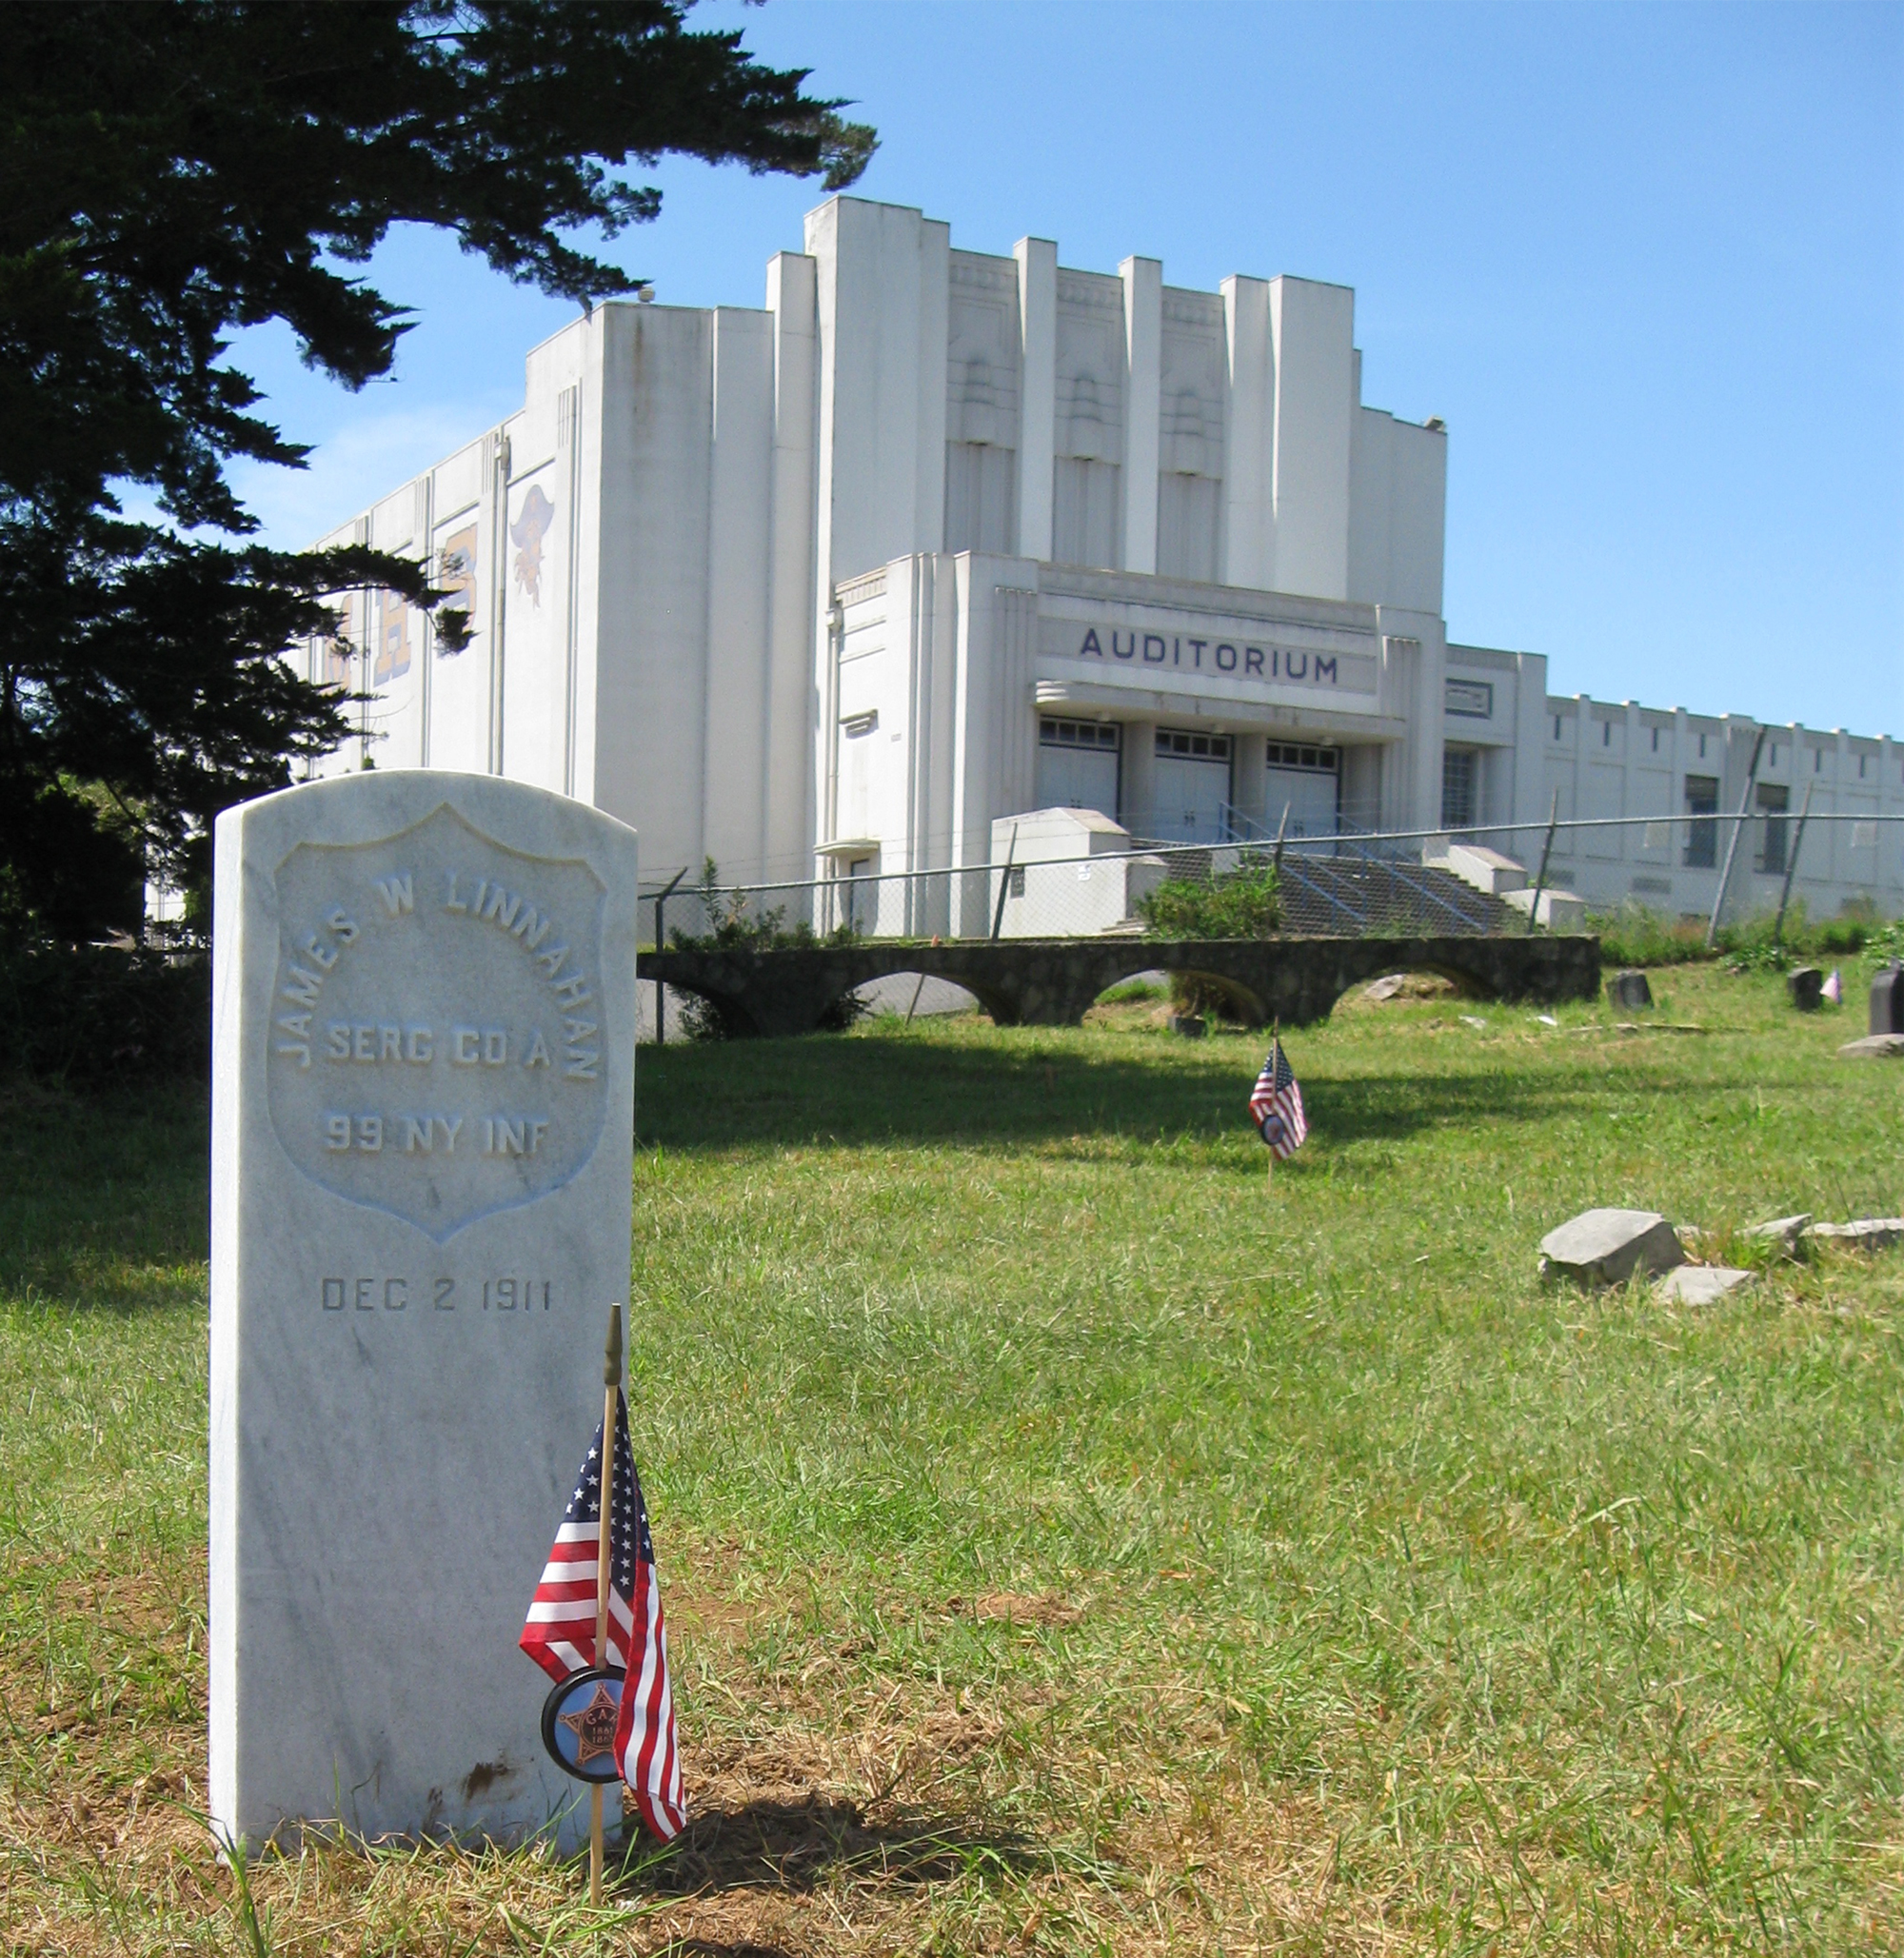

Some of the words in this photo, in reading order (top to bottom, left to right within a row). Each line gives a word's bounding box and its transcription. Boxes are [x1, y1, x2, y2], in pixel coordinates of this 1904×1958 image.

[1080, 626, 1339, 684] AUDITORIUM
[276, 900, 360, 1070] JAMES
[375, 870, 414, 920] W
[444, 869, 599, 1082] LINNAHAN
[326, 1020, 433, 1067] SERG
[453, 1026, 508, 1071] CO
[524, 1028, 551, 1070] A
[326, 1113, 383, 1155] 99
[402, 1114, 463, 1155] NY
[483, 1116, 549, 1157] INF
[322, 1277, 407, 1311] DEC
[434, 1277, 456, 1311] 2
[483, 1277, 551, 1311] 1911
